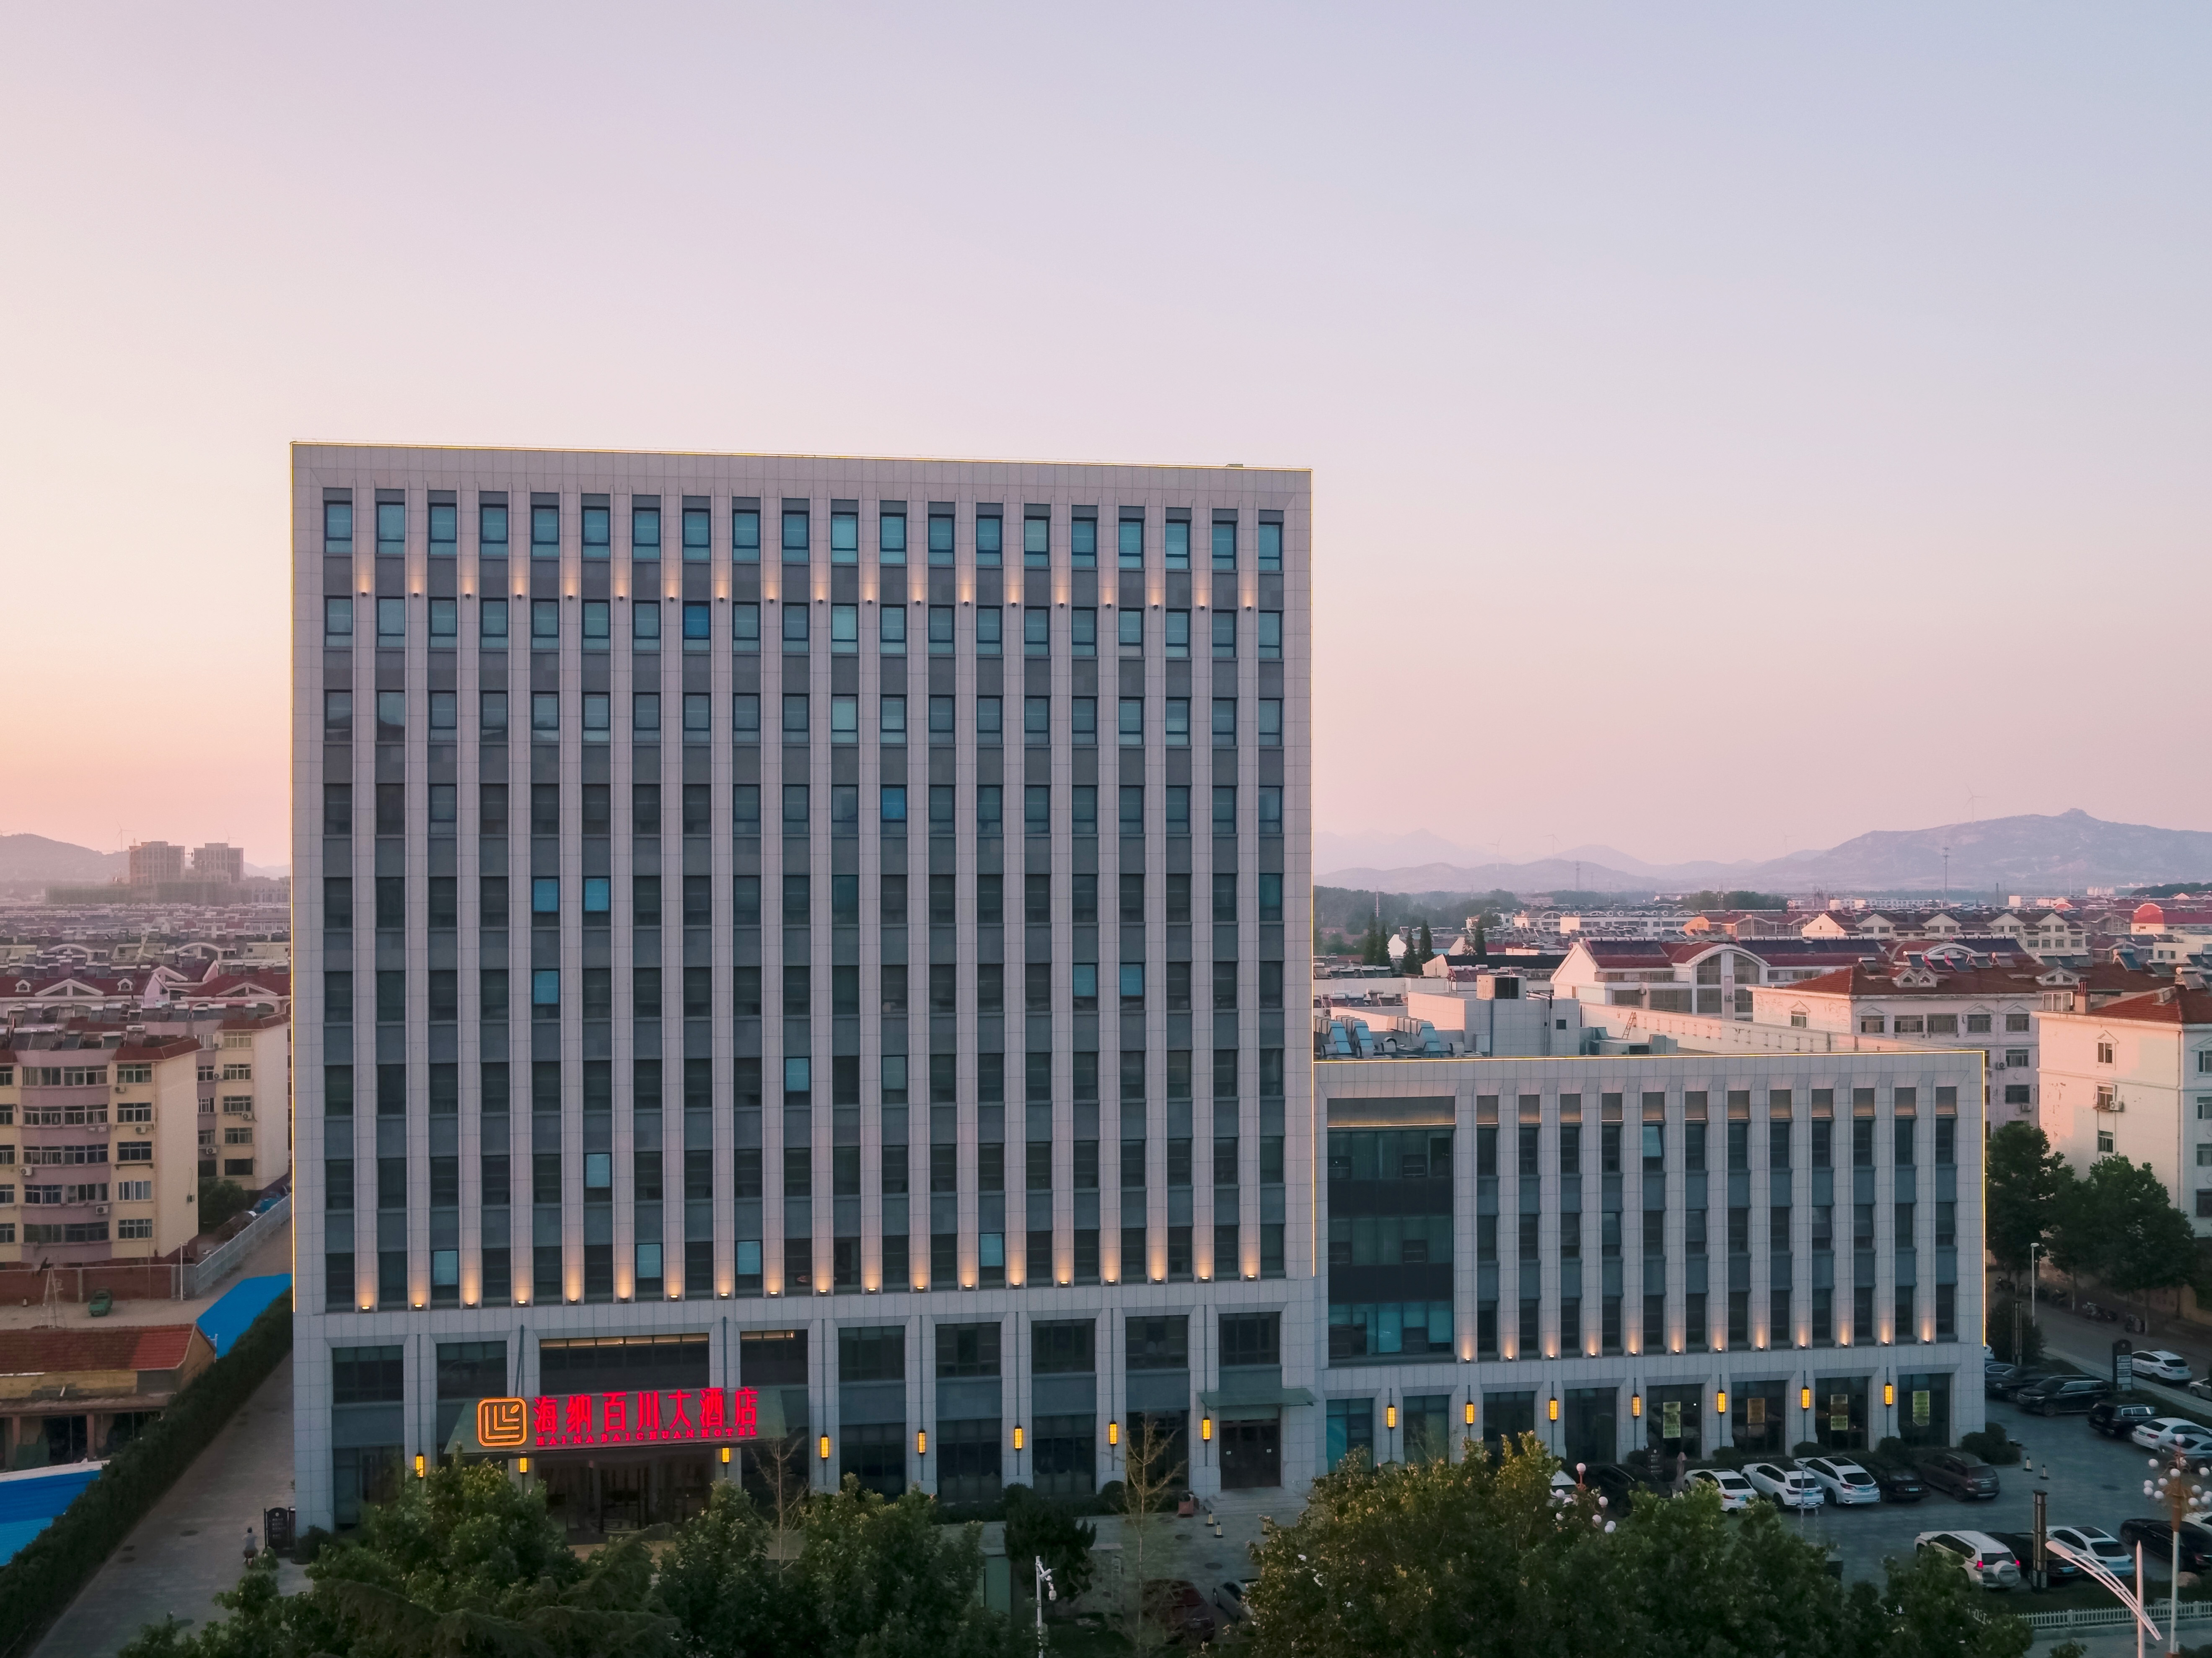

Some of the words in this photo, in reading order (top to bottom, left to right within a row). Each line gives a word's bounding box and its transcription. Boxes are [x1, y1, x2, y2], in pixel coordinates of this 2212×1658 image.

[533, 1387, 758, 1435] 海纳百川大酒店
[701, 1426, 757, 1438] HOTEL
